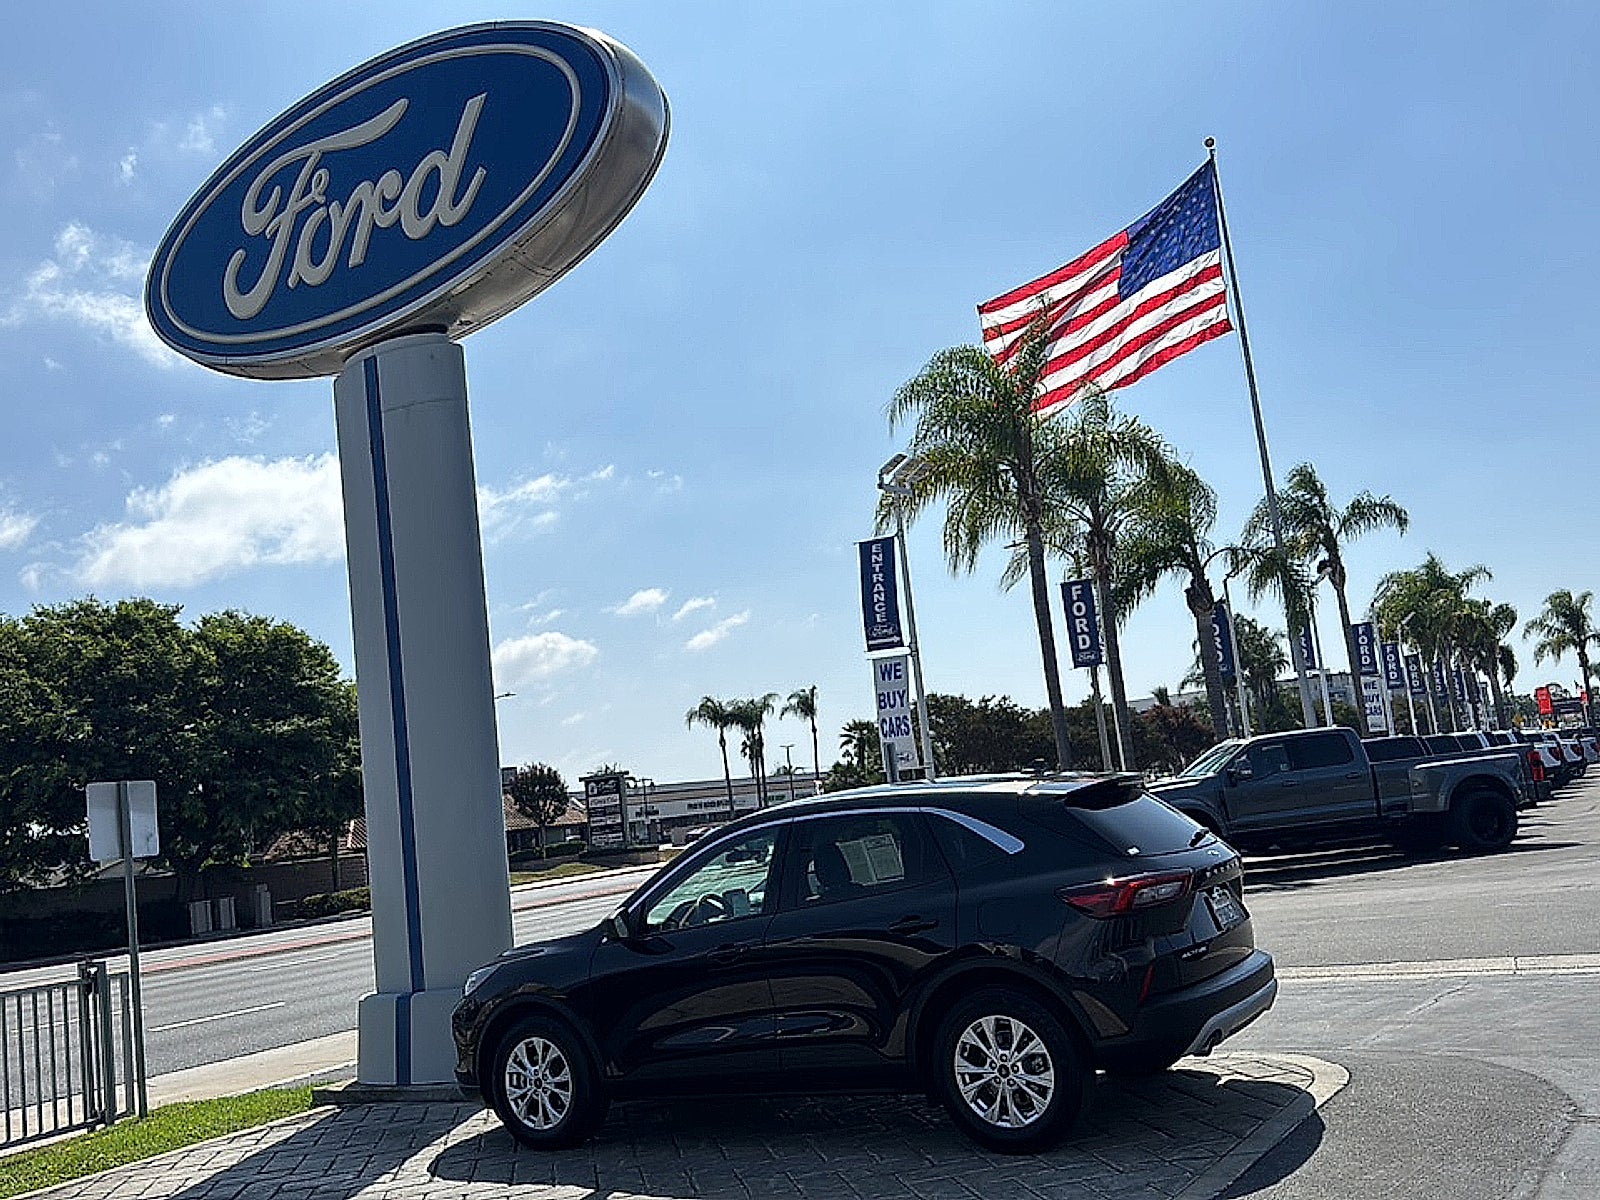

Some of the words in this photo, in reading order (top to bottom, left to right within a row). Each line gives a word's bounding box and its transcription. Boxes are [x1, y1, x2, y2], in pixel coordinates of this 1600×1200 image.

[223, 92, 487, 320] Ford
[872, 543, 888, 623] ENTRANCE
[1071, 585, 1091, 650] FORD
[1358, 625, 1371, 665] FORD
[1386, 645, 1398, 680] FORD
[880, 662, 902, 681] WE
[878, 689, 906, 709] BUY
[881, 715, 911, 738] CARS
